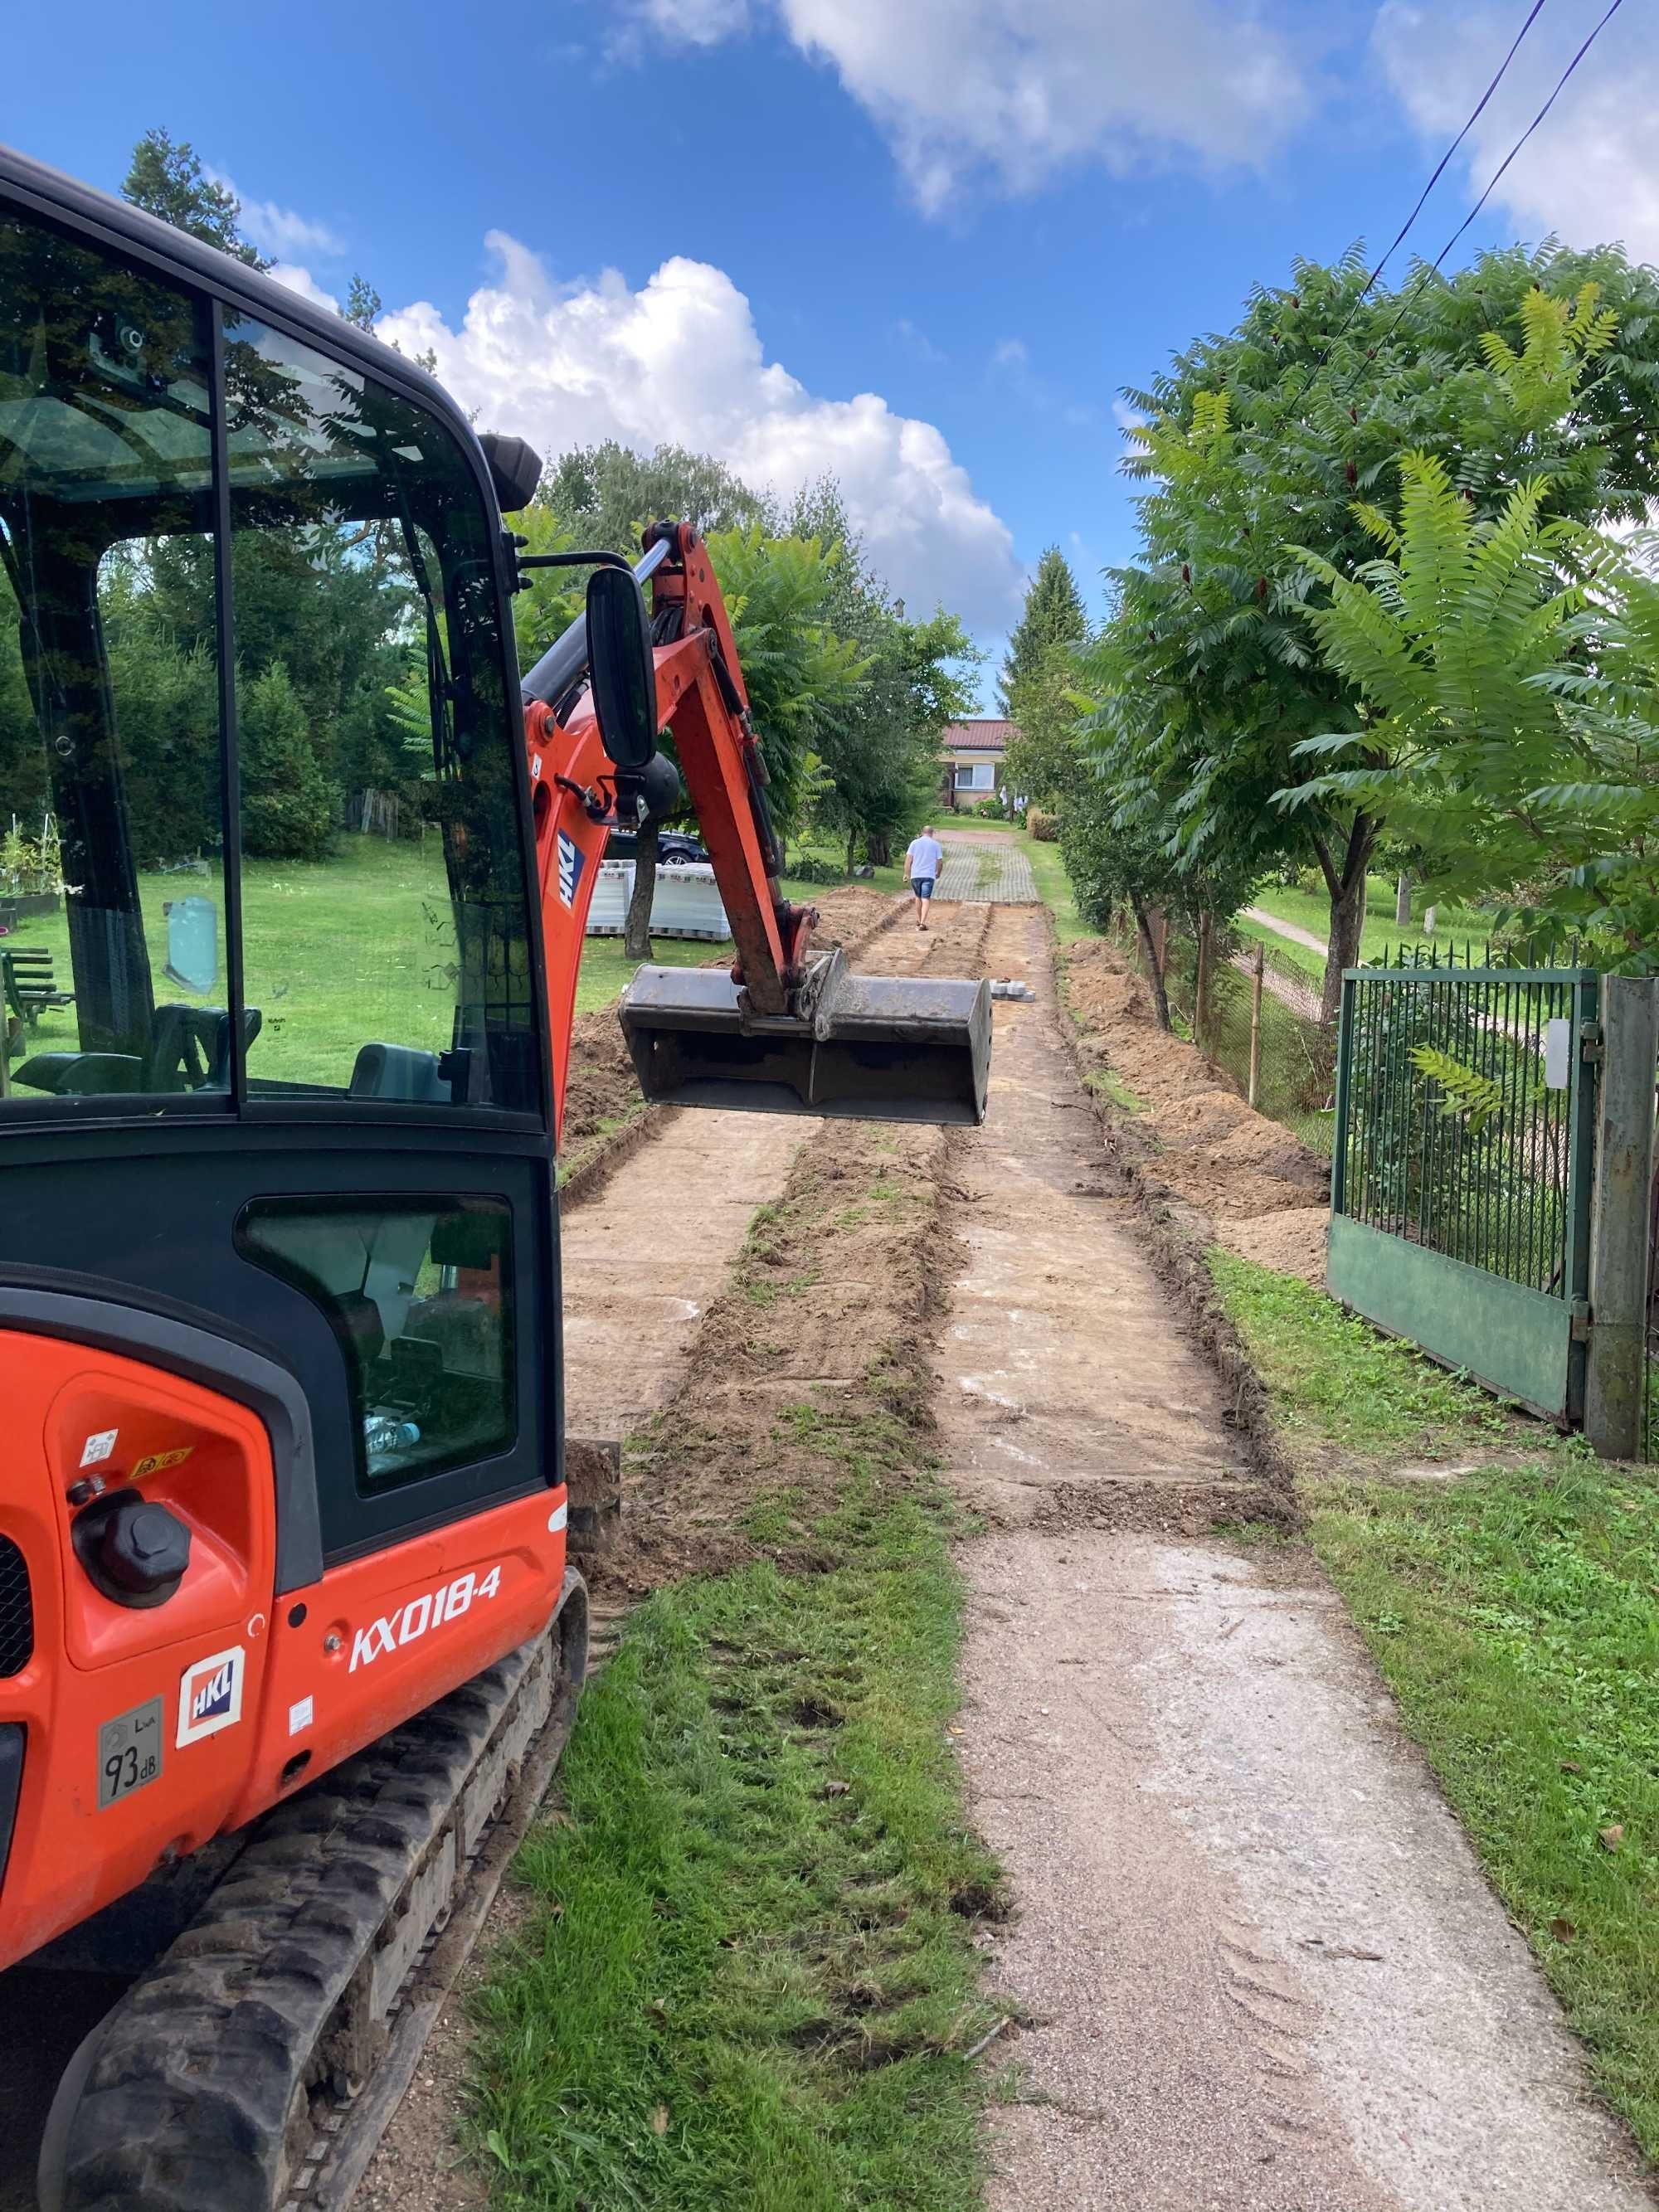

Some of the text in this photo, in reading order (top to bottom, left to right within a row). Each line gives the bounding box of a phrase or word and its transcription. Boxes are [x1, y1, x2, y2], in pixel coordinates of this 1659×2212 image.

[557, 833, 577, 910] HKL
[348, 1566, 501, 1673] KX018-4
[192, 1660, 231, 1720] HKL
[105, 1746, 156, 1796] 93 dB
